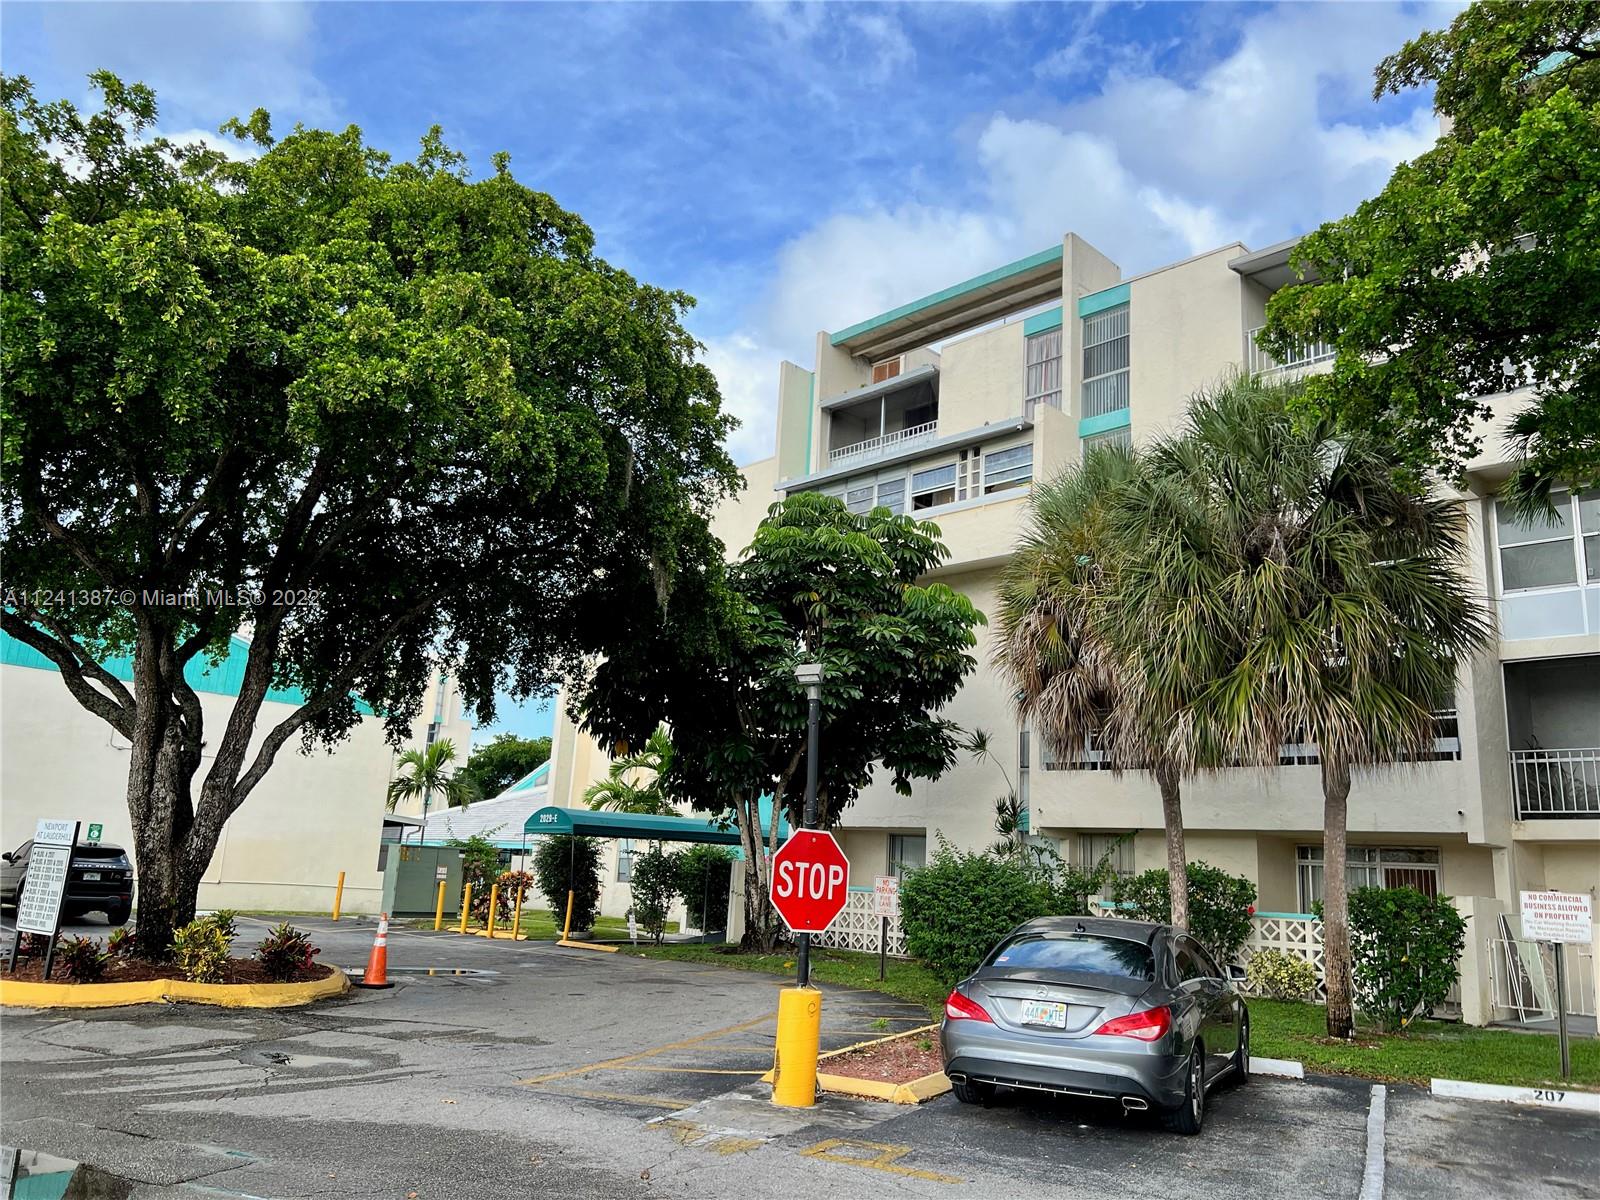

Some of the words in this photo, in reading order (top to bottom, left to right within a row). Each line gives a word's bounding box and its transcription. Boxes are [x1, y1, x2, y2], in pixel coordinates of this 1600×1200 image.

[45, 822, 68, 831] NEWPORT
[44, 832, 72, 841] LAUDERHILL
[776, 860, 844, 900] STOP
[882, 879, 890, 887] NO
[876, 886, 897, 895] PARKING
[1538, 894, 1583, 903] COMMERCIAL
[1524, 902, 1556, 911] BUSINESS
[1557, 904, 1588, 913] ALLOWED
[1544, 912, 1578, 921] PROPERTY
[1533, 1089, 1566, 1102] 207
